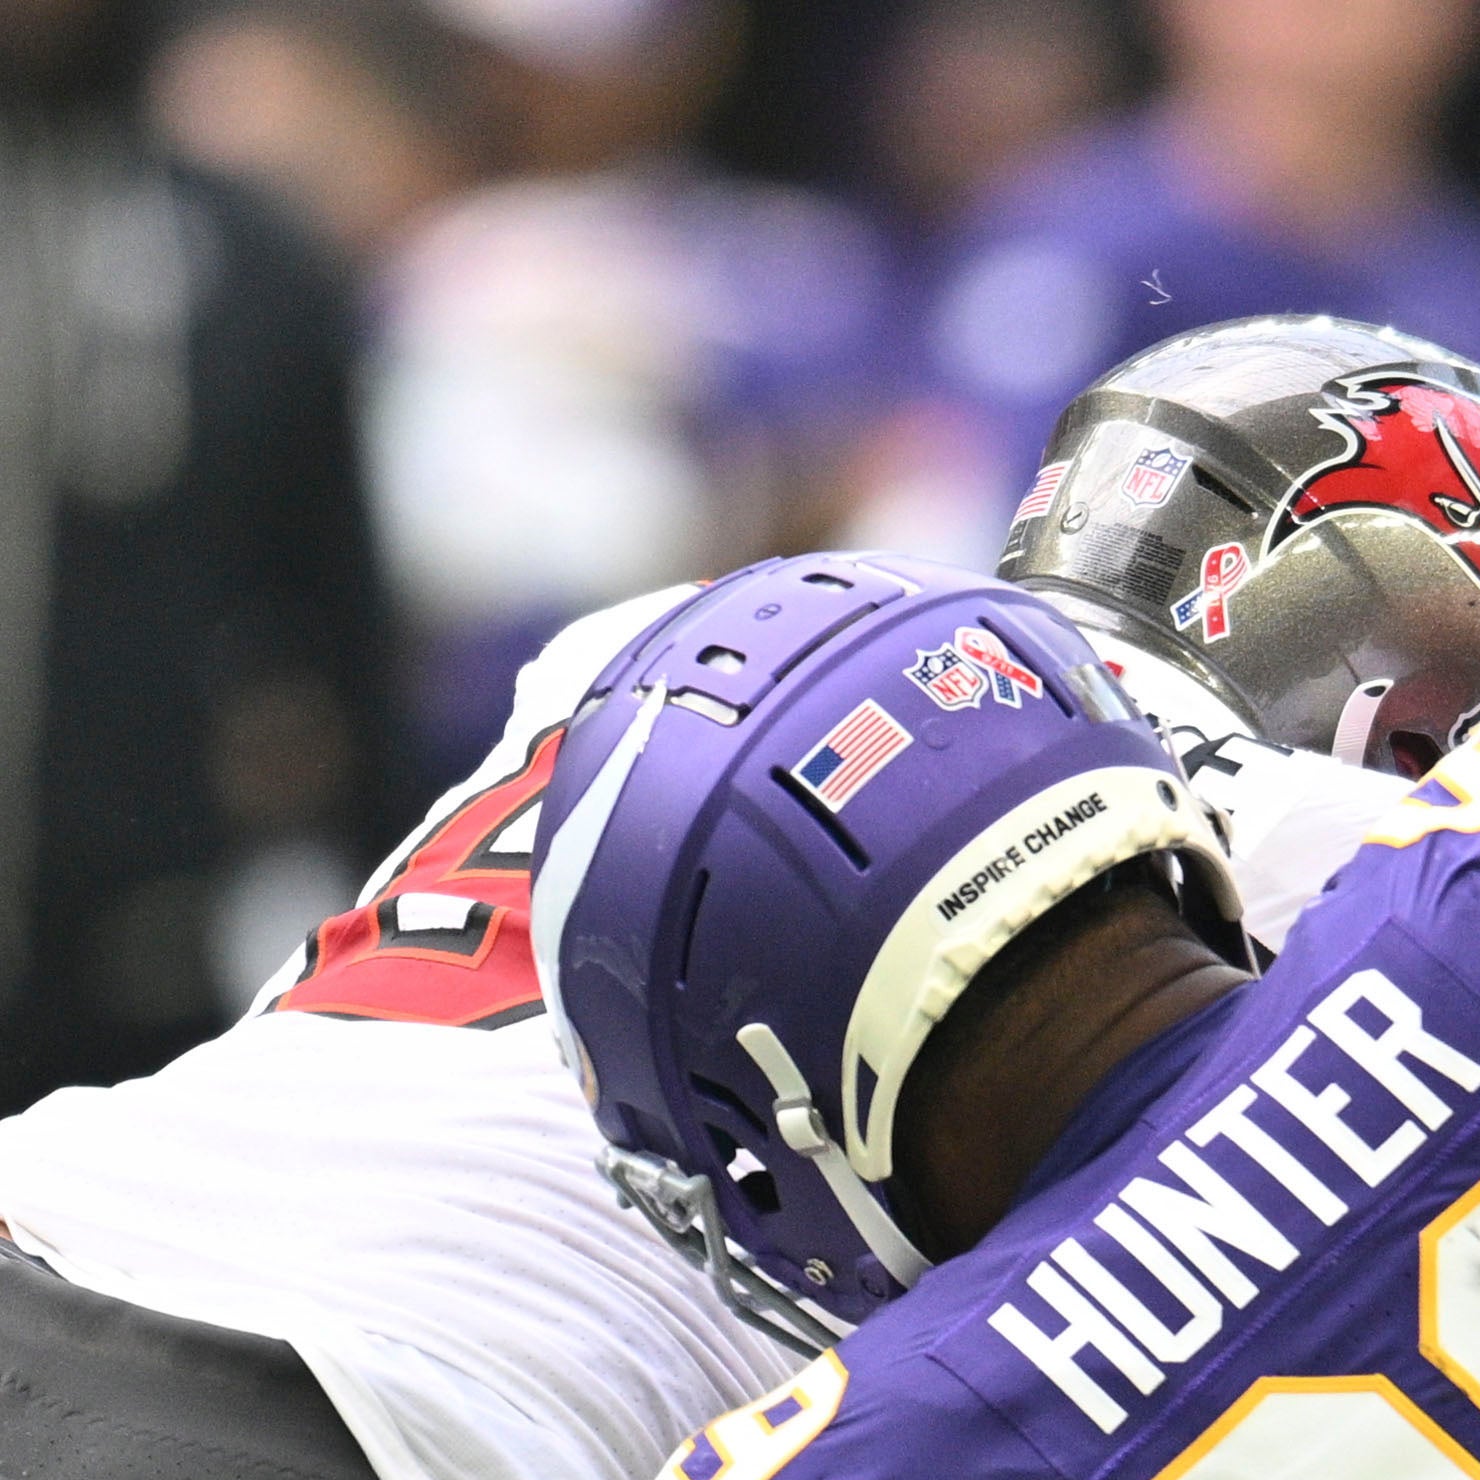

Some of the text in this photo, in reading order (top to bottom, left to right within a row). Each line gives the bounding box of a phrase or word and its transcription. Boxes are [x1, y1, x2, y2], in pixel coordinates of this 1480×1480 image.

[1126, 466, 1168, 500] NFL
[930, 667, 980, 701] NFL
[937, 792, 1107, 921] INSPIRE CHANGE
